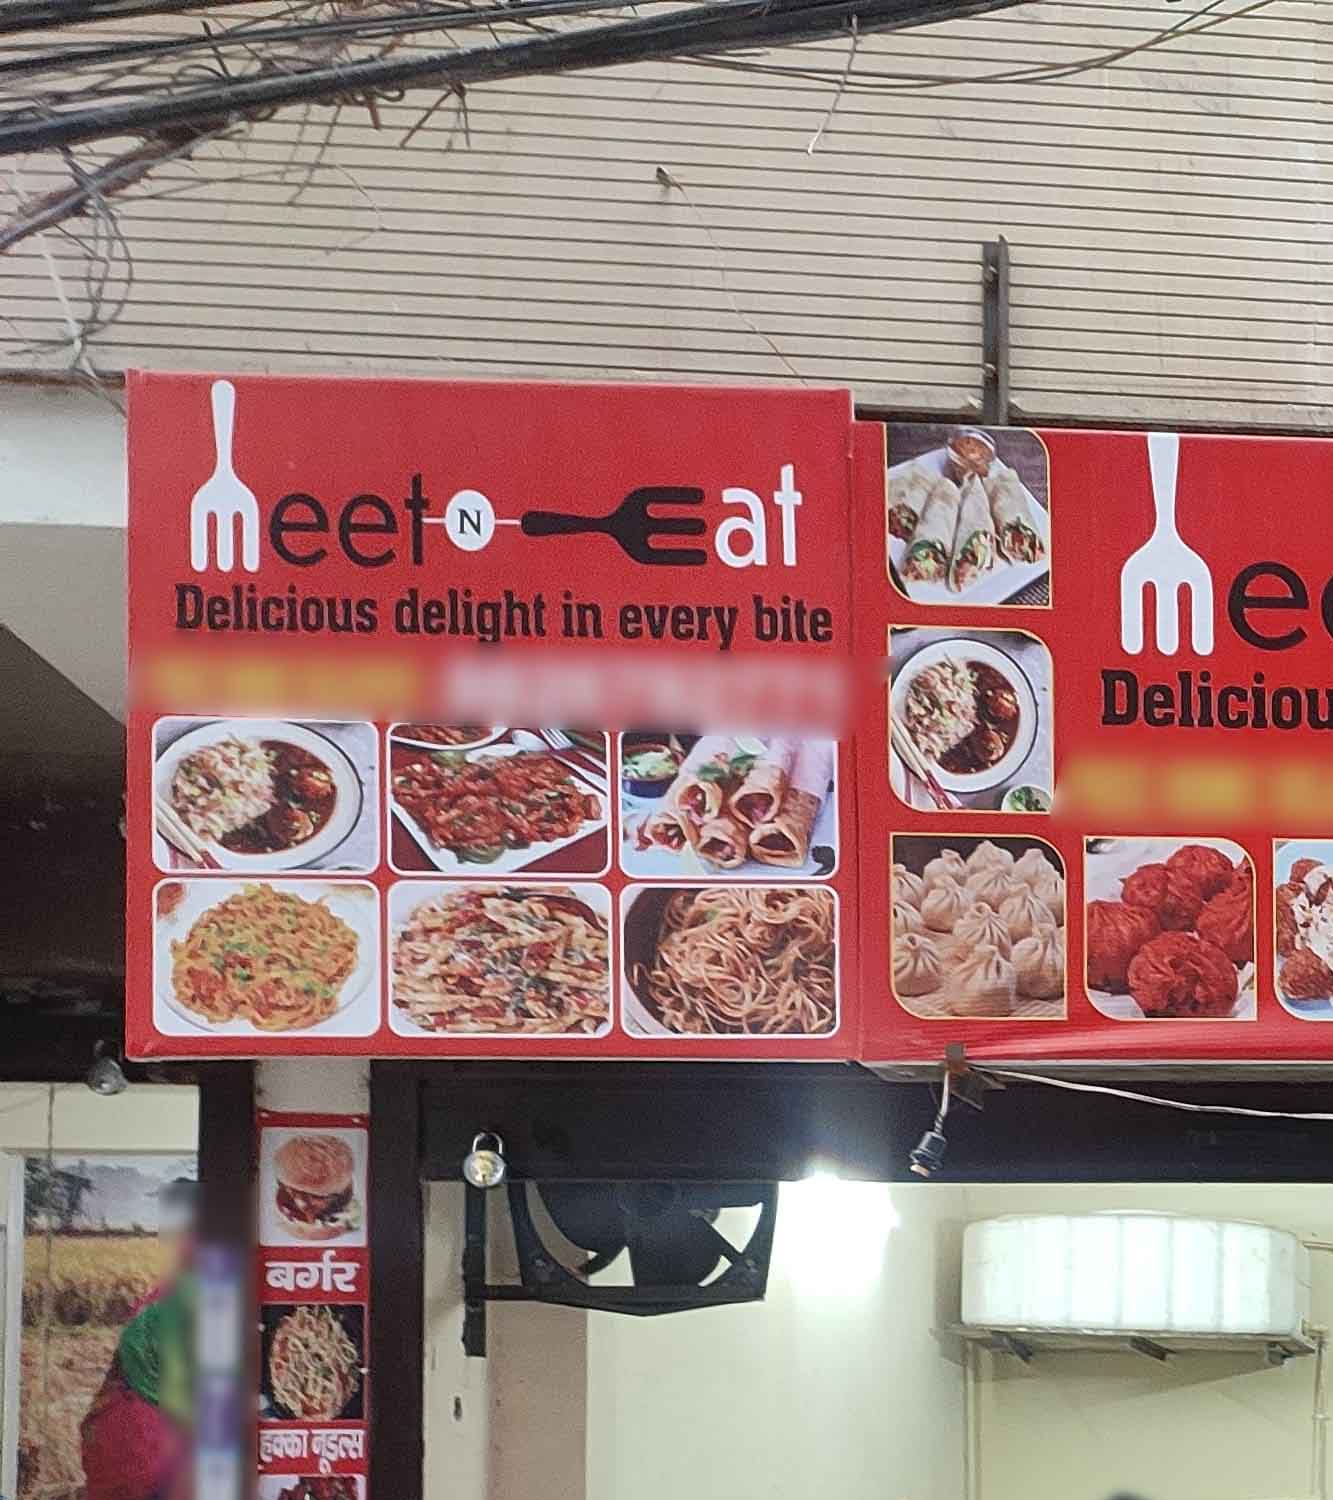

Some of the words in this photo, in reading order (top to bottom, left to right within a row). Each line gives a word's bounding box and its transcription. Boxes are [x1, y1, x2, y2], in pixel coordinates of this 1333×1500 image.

[175, 583, 378, 633] Delicious
[394, 590, 546, 644] delight
[561, 592, 604, 639] in
[618, 600, 738, 652] every
[753, 596, 833, 643] bite
[265, 1249, 361, 1293] बर्गर
[259, 1428, 309, 1462] हक्का
